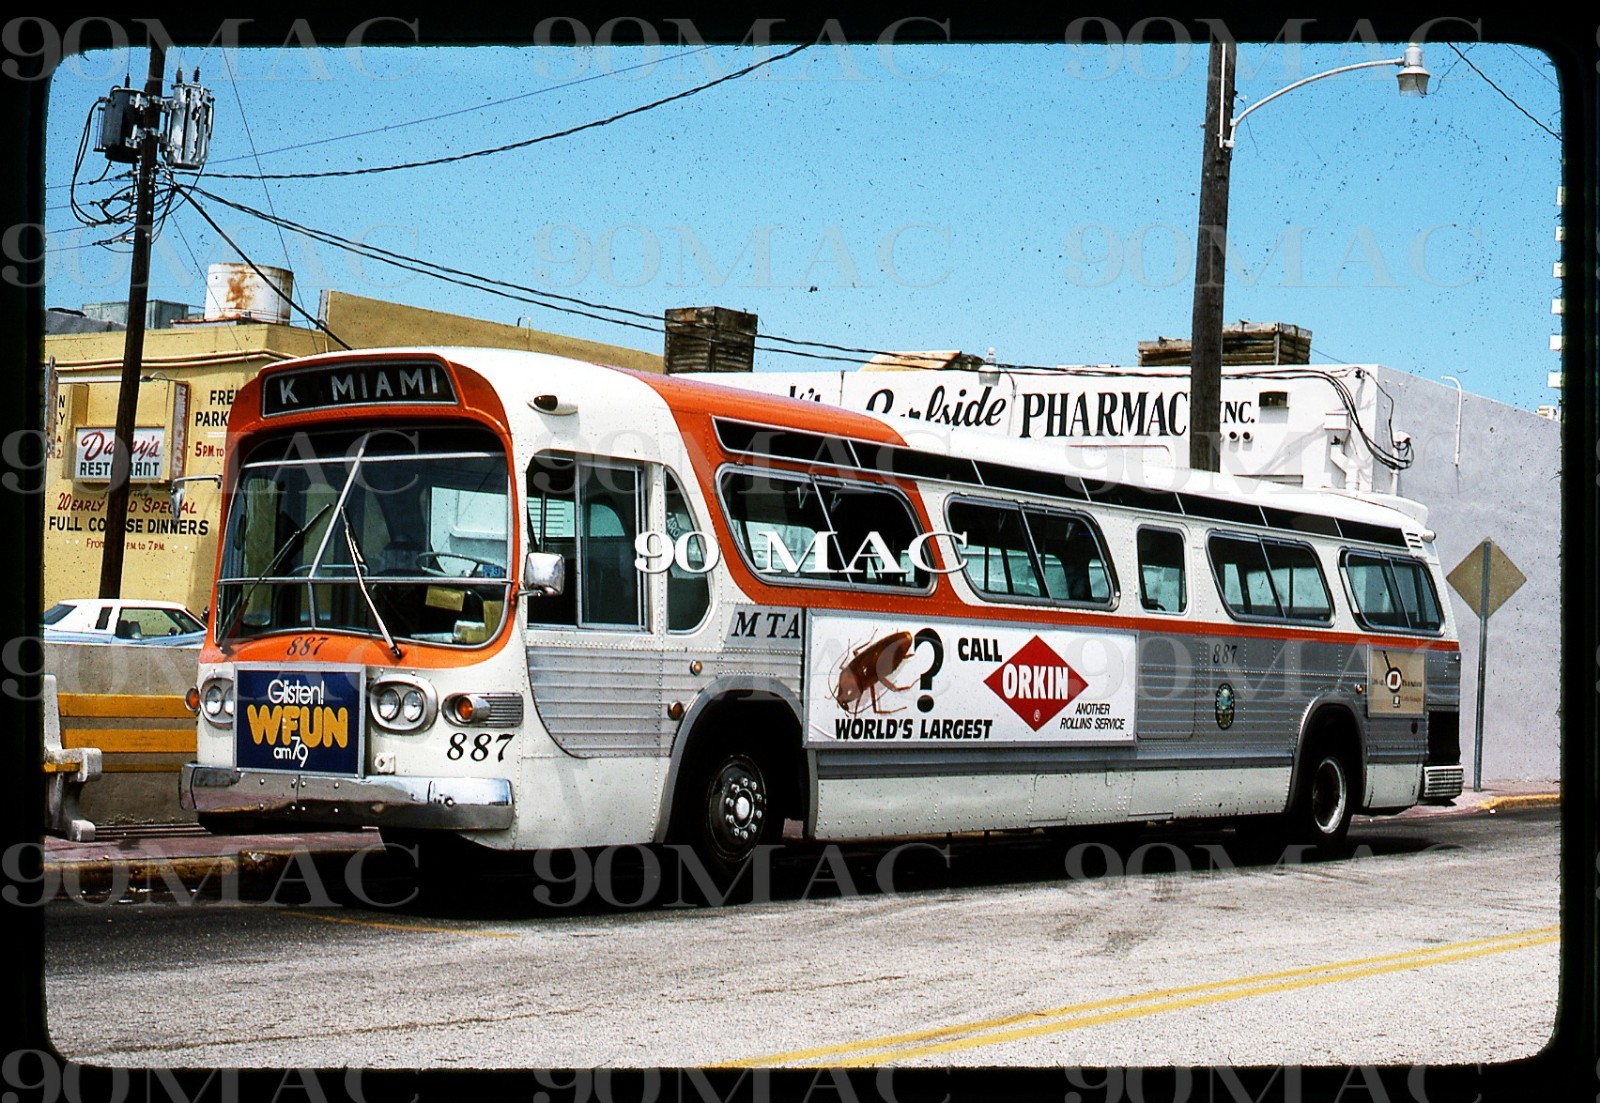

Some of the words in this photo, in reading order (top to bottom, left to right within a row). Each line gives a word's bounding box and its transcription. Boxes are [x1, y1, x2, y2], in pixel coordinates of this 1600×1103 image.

[279, 377, 299, 405] K
[331, 367, 438, 401] MIAMI
[1019, 391, 1191, 438] PHARMAC
[80, 462, 160, 476] RESTANT
[49, 516, 82, 532] FULL
[89, 517, 143, 533] COSE
[148, 518, 209, 536] DINNERS
[286, 637, 329, 656] 887
[958, 637, 1003, 662] CALL
[1212, 644, 1238, 665] 887
[268, 679, 325, 705] Glisten!
[1002, 663, 1069, 700] ORKIN
[1075, 702, 1111, 715] ANOTHER
[247, 704, 348, 748] WFUN
[835, 717, 913, 740] WORLD'S
[919, 717, 993, 740] LARGEST
[1060, 717, 1093, 730] ROLLINS
[1094, 717, 1126, 730] SERVICE
[446, 732, 515, 762] 887
